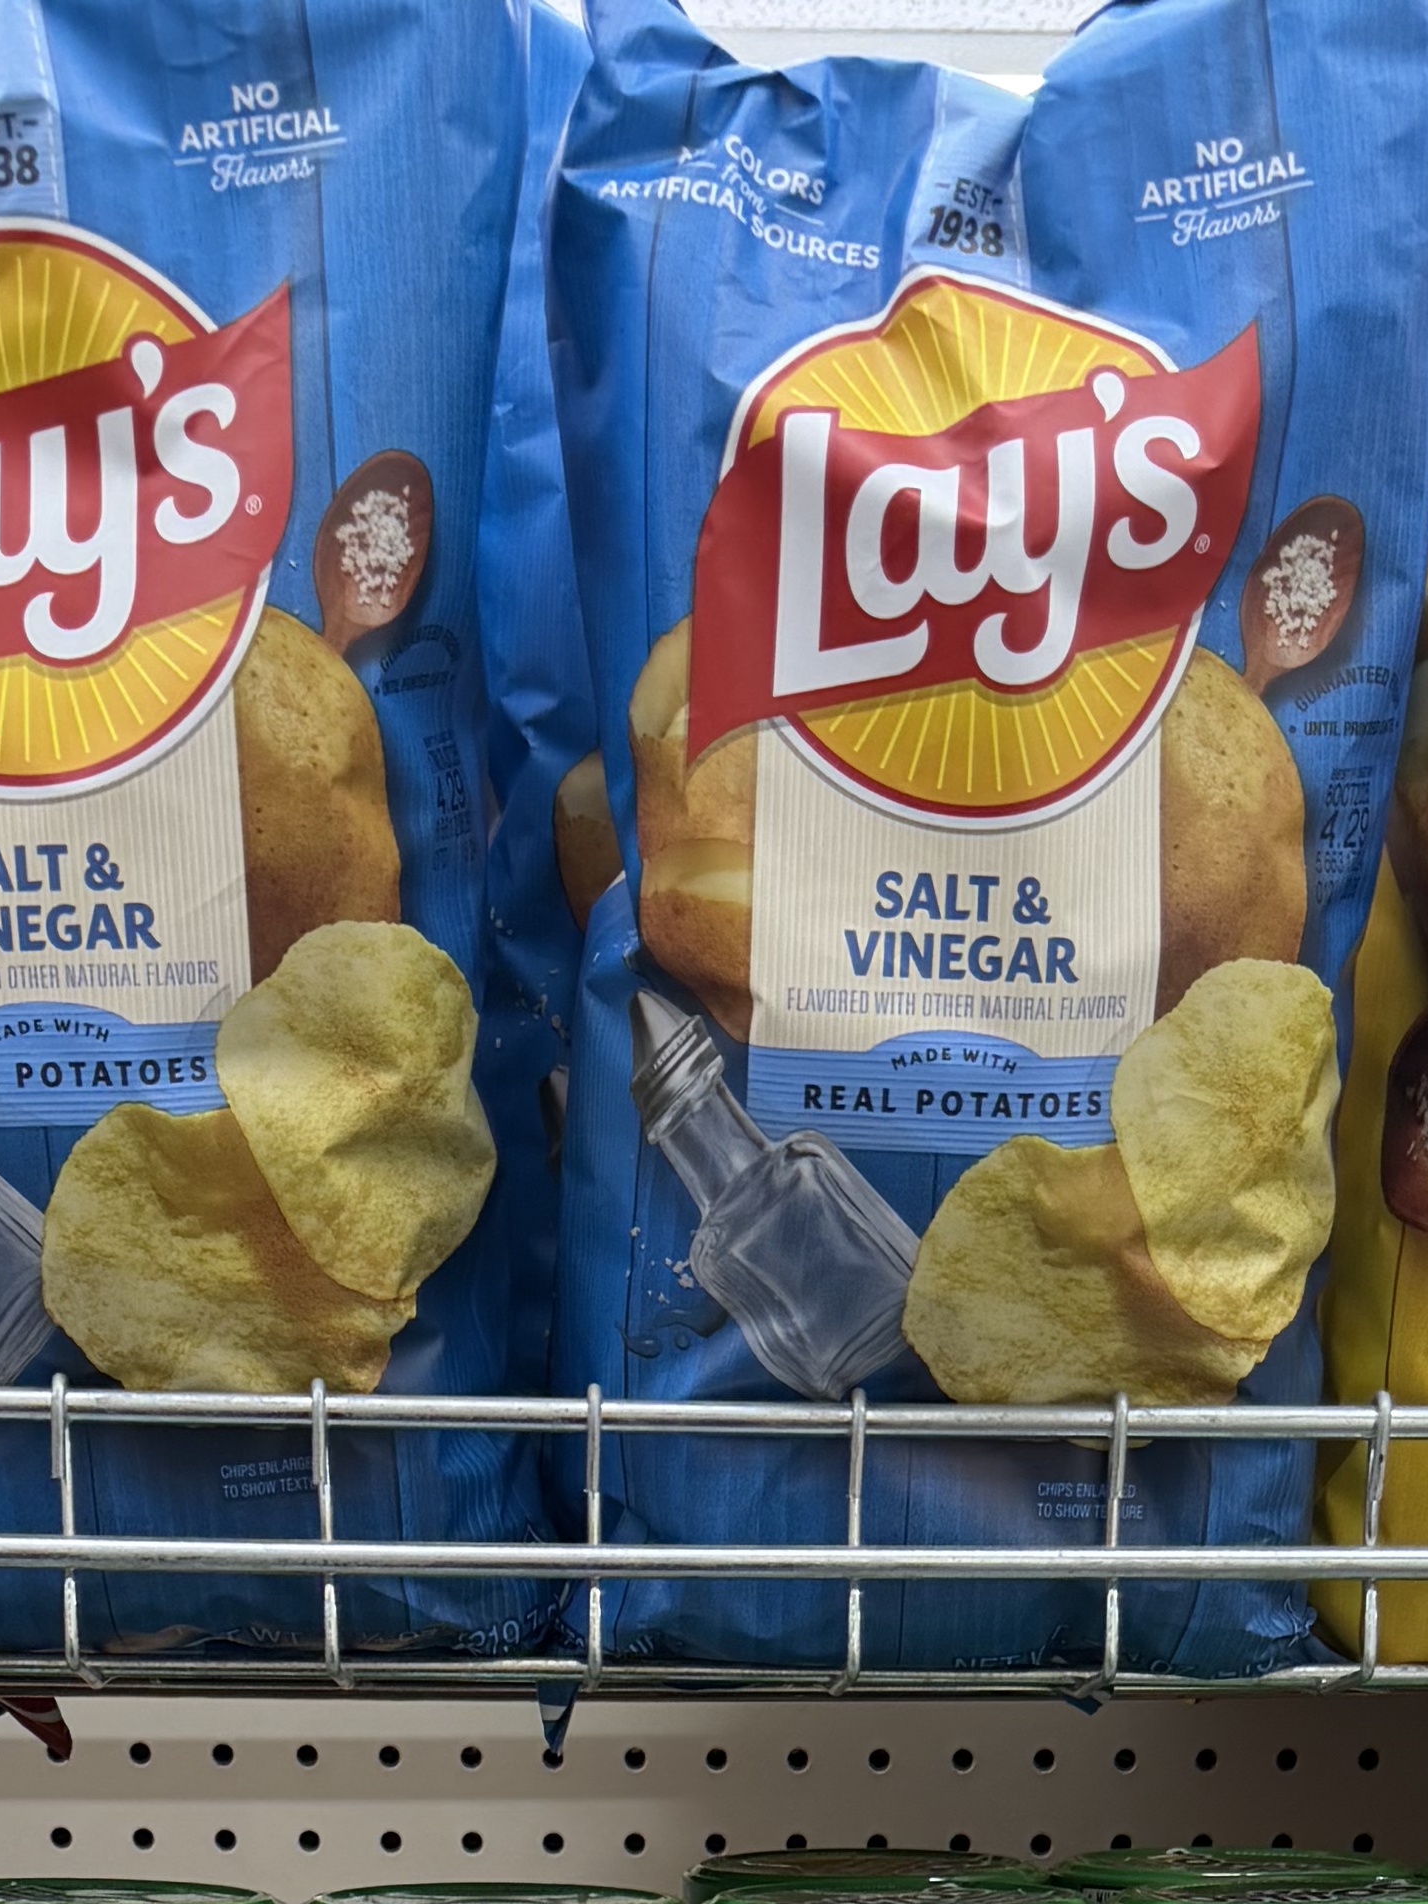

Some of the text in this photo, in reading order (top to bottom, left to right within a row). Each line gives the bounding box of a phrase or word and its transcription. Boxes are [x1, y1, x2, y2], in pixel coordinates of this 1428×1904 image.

[232, 82, 280, 112] NO
[179, 107, 340, 152] ARTIFICIAL
[209, 155, 315, 191] Flavors
[772, 372, 1201, 698] Lay's
[84, 842, 123, 893] &
[874, 870, 1052, 925] SALT &
[6, 963, 59, 991] OTHER
[63, 963, 140, 990] NATURAL
[145, 960, 219, 988] FLAVORS
[843, 929, 1079, 984] VINEGAR
[15, 1055, 208, 1090] POTATOES
